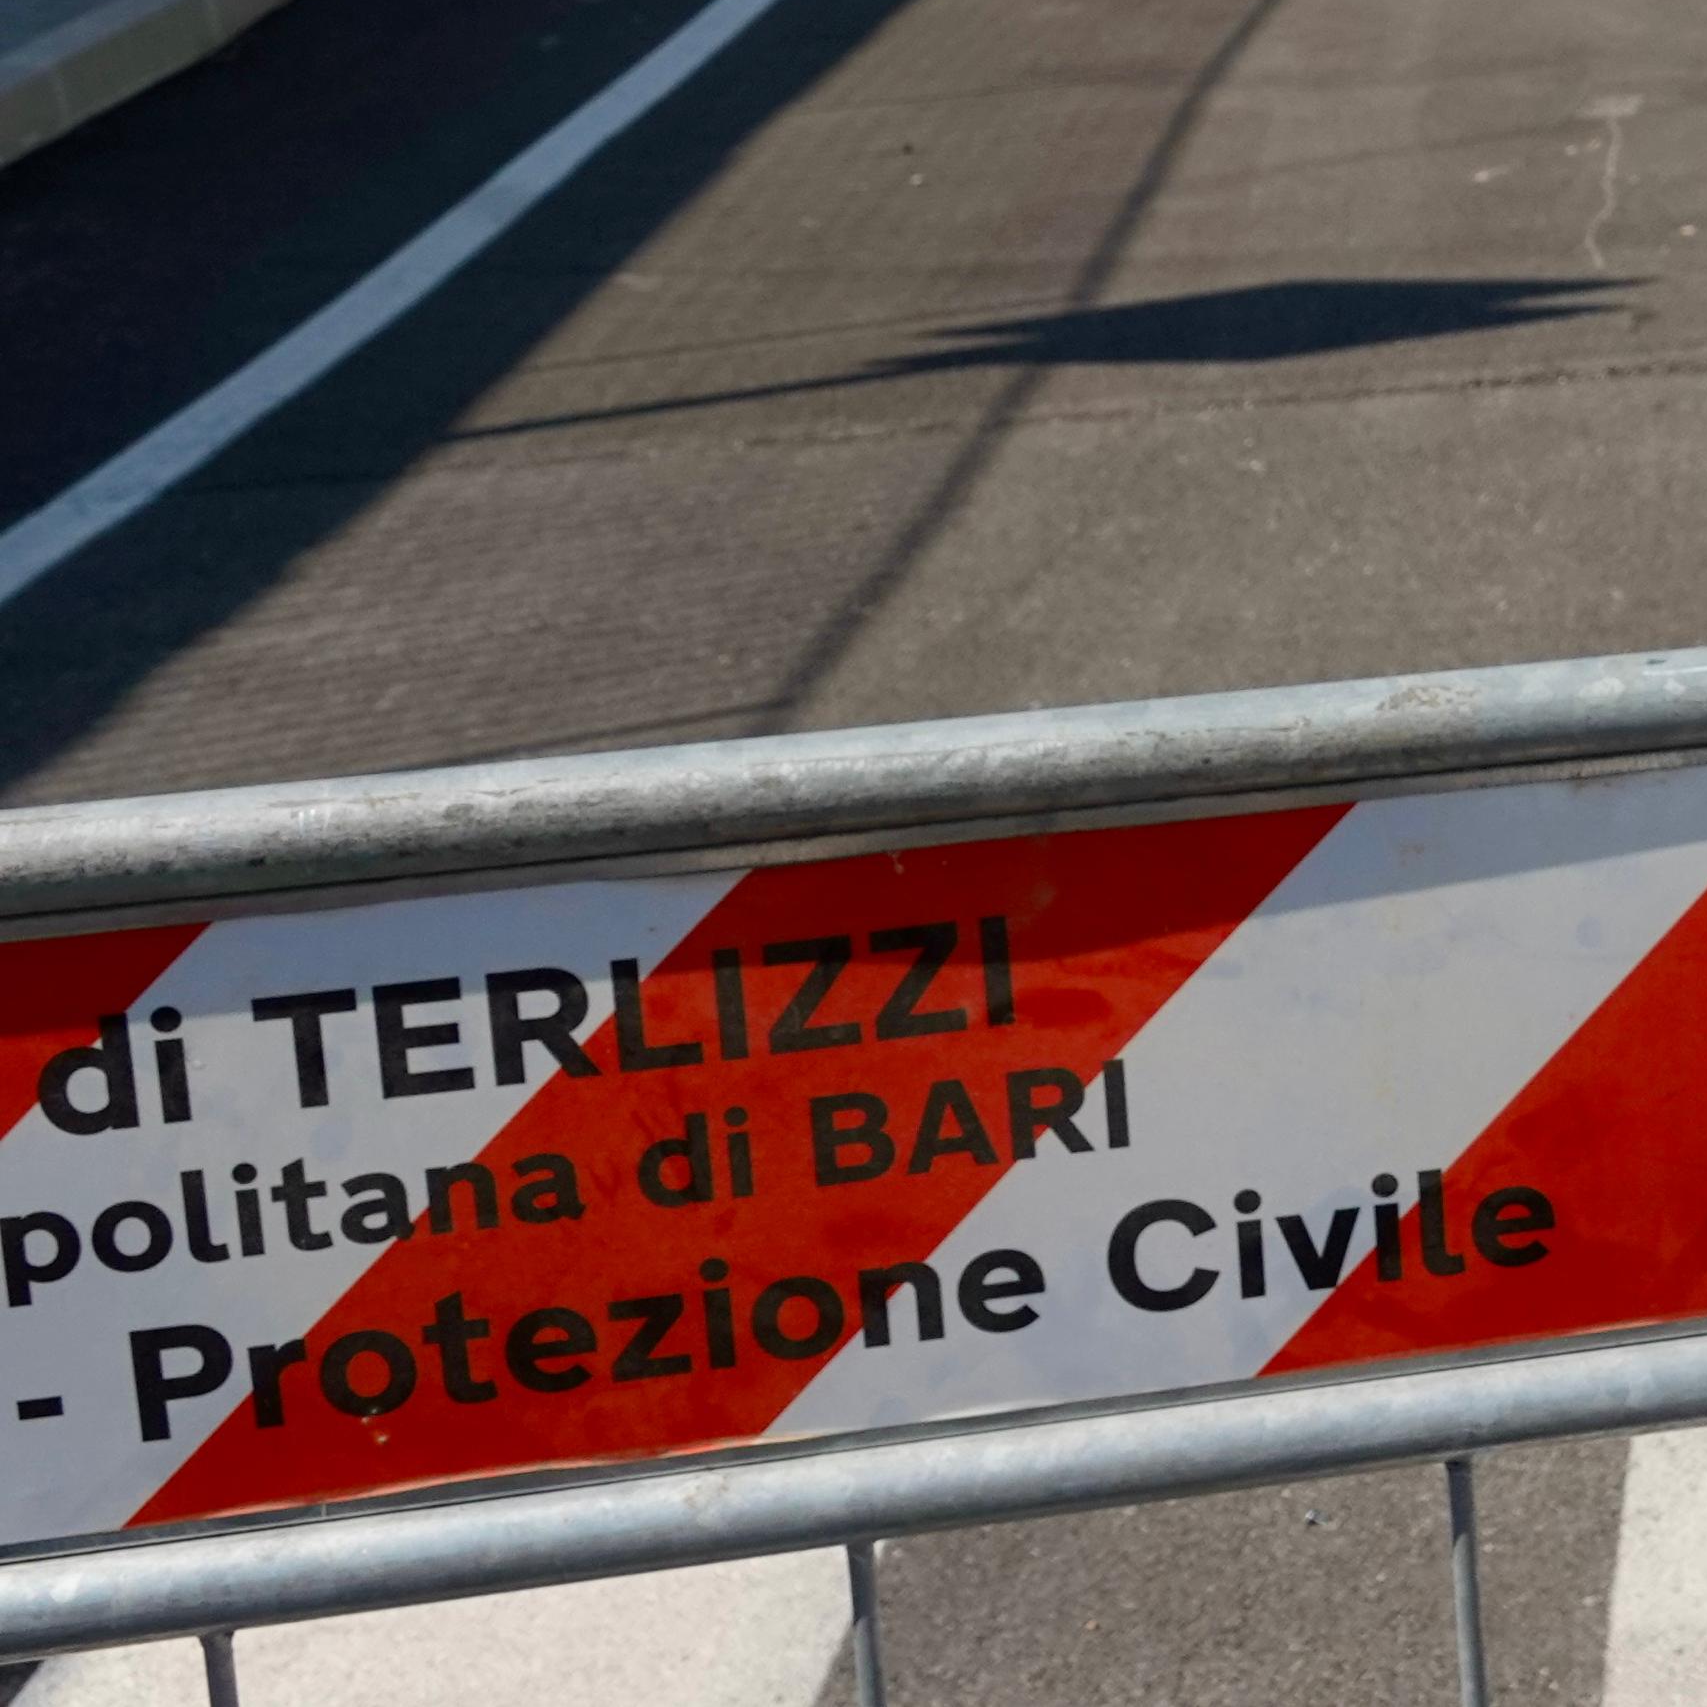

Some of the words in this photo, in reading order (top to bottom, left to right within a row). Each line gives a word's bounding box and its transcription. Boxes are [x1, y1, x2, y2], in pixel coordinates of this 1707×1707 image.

[38, 1006, 192, 1135] di
[252, 916, 1017, 1108] TERLIZZI
[0, 1155, 586, 1307] politana
[638, 1108, 754, 1208] di
[811, 1059, 1131, 1187] BARI
[129, 1246, 1047, 1443] Protezione
[1107, 1168, 1555, 1313] Civile
